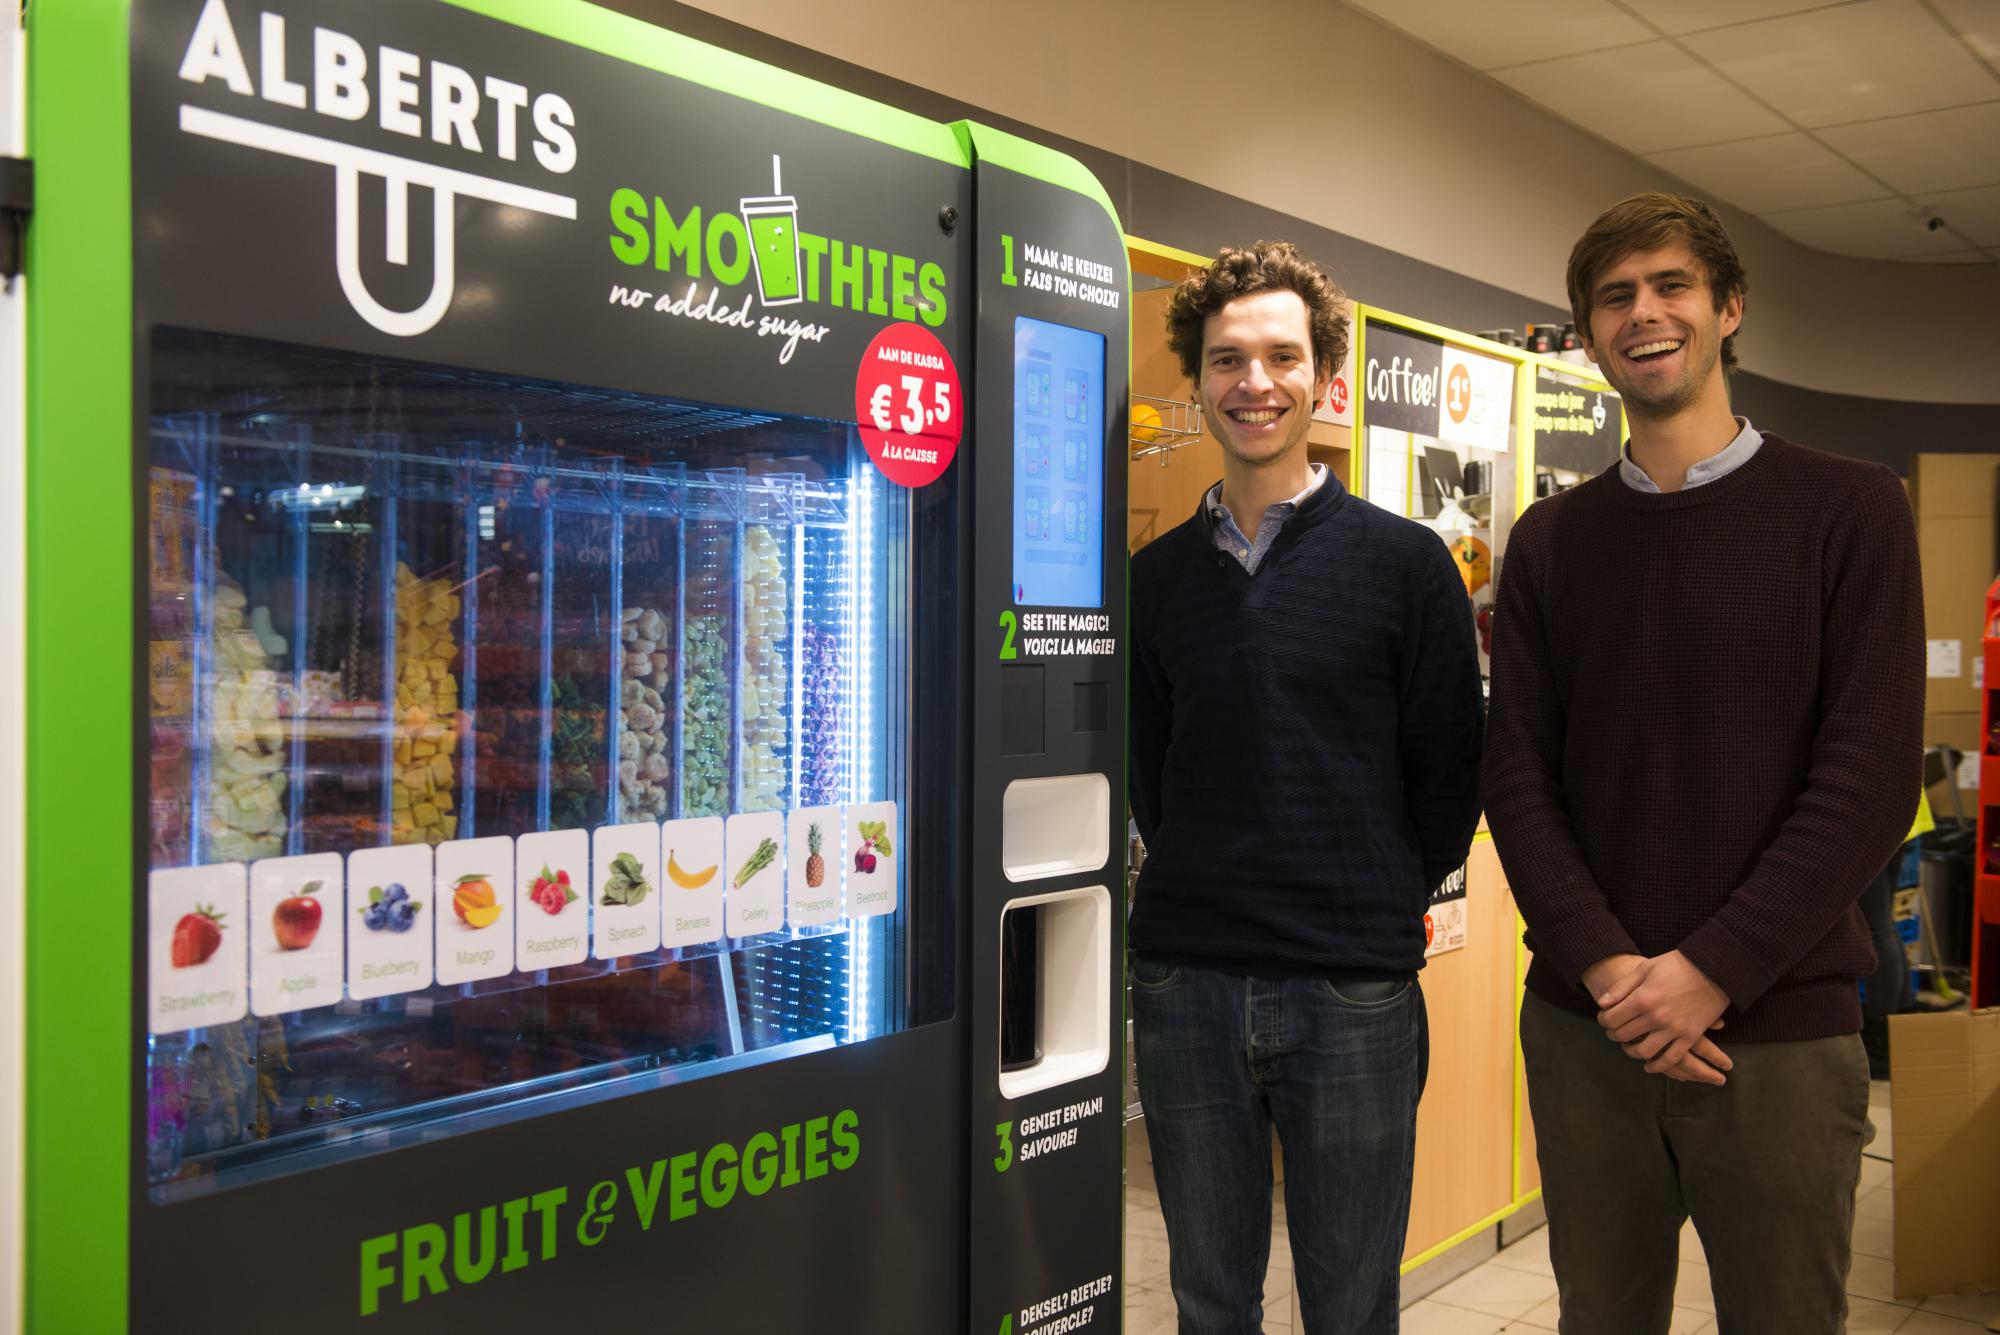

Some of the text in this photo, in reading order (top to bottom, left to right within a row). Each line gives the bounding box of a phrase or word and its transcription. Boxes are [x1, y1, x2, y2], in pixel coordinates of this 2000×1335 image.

[179, 0, 577, 173] ALBERTS
[1001, 234, 1018, 287] 1
[1024, 243, 1113, 284] MAAK JE KEUZE!
[1024, 268, 1119, 308] FAIS TON CHOIX!
[609, 282, 830, 365] no added sugar
[878, 346, 944, 371] AAN DE KASSA
[1367, 356, 1439, 408] Coffee!
[870, 374, 951, 435] € 3,5
[882, 441, 938, 464] À LA CAISSE
[999, 609, 1017, 660] 2
[1023, 613, 1109, 632] SEE THE MAGIC!
[1024, 638, 1116, 655] VOICI LA MAGIE!
[857, 889, 888, 904] Beetroot
[676, 917, 710, 931] Banana
[742, 907, 769, 921] Celery
[526, 936, 579, 953] Raspberry
[608, 925, 647, 942] Spinach
[362, 959, 420, 981] Blueberry
[456, 948, 496, 966] Mango
[278, 973, 317, 994] Apple
[159, 989, 237, 1012] Strawberry
[1020, 1096, 1103, 1136] GENIET ERVAN!
[994, 1120, 1013, 1173] 3
[1020, 1127, 1078, 1161] SAVOURE!
[360, 1109, 860, 1317] FRUIT & VEGGIES
[1020, 1293, 1068, 1327] DEKSEL?
[1070, 1275, 1112, 1306] RIETJE?
